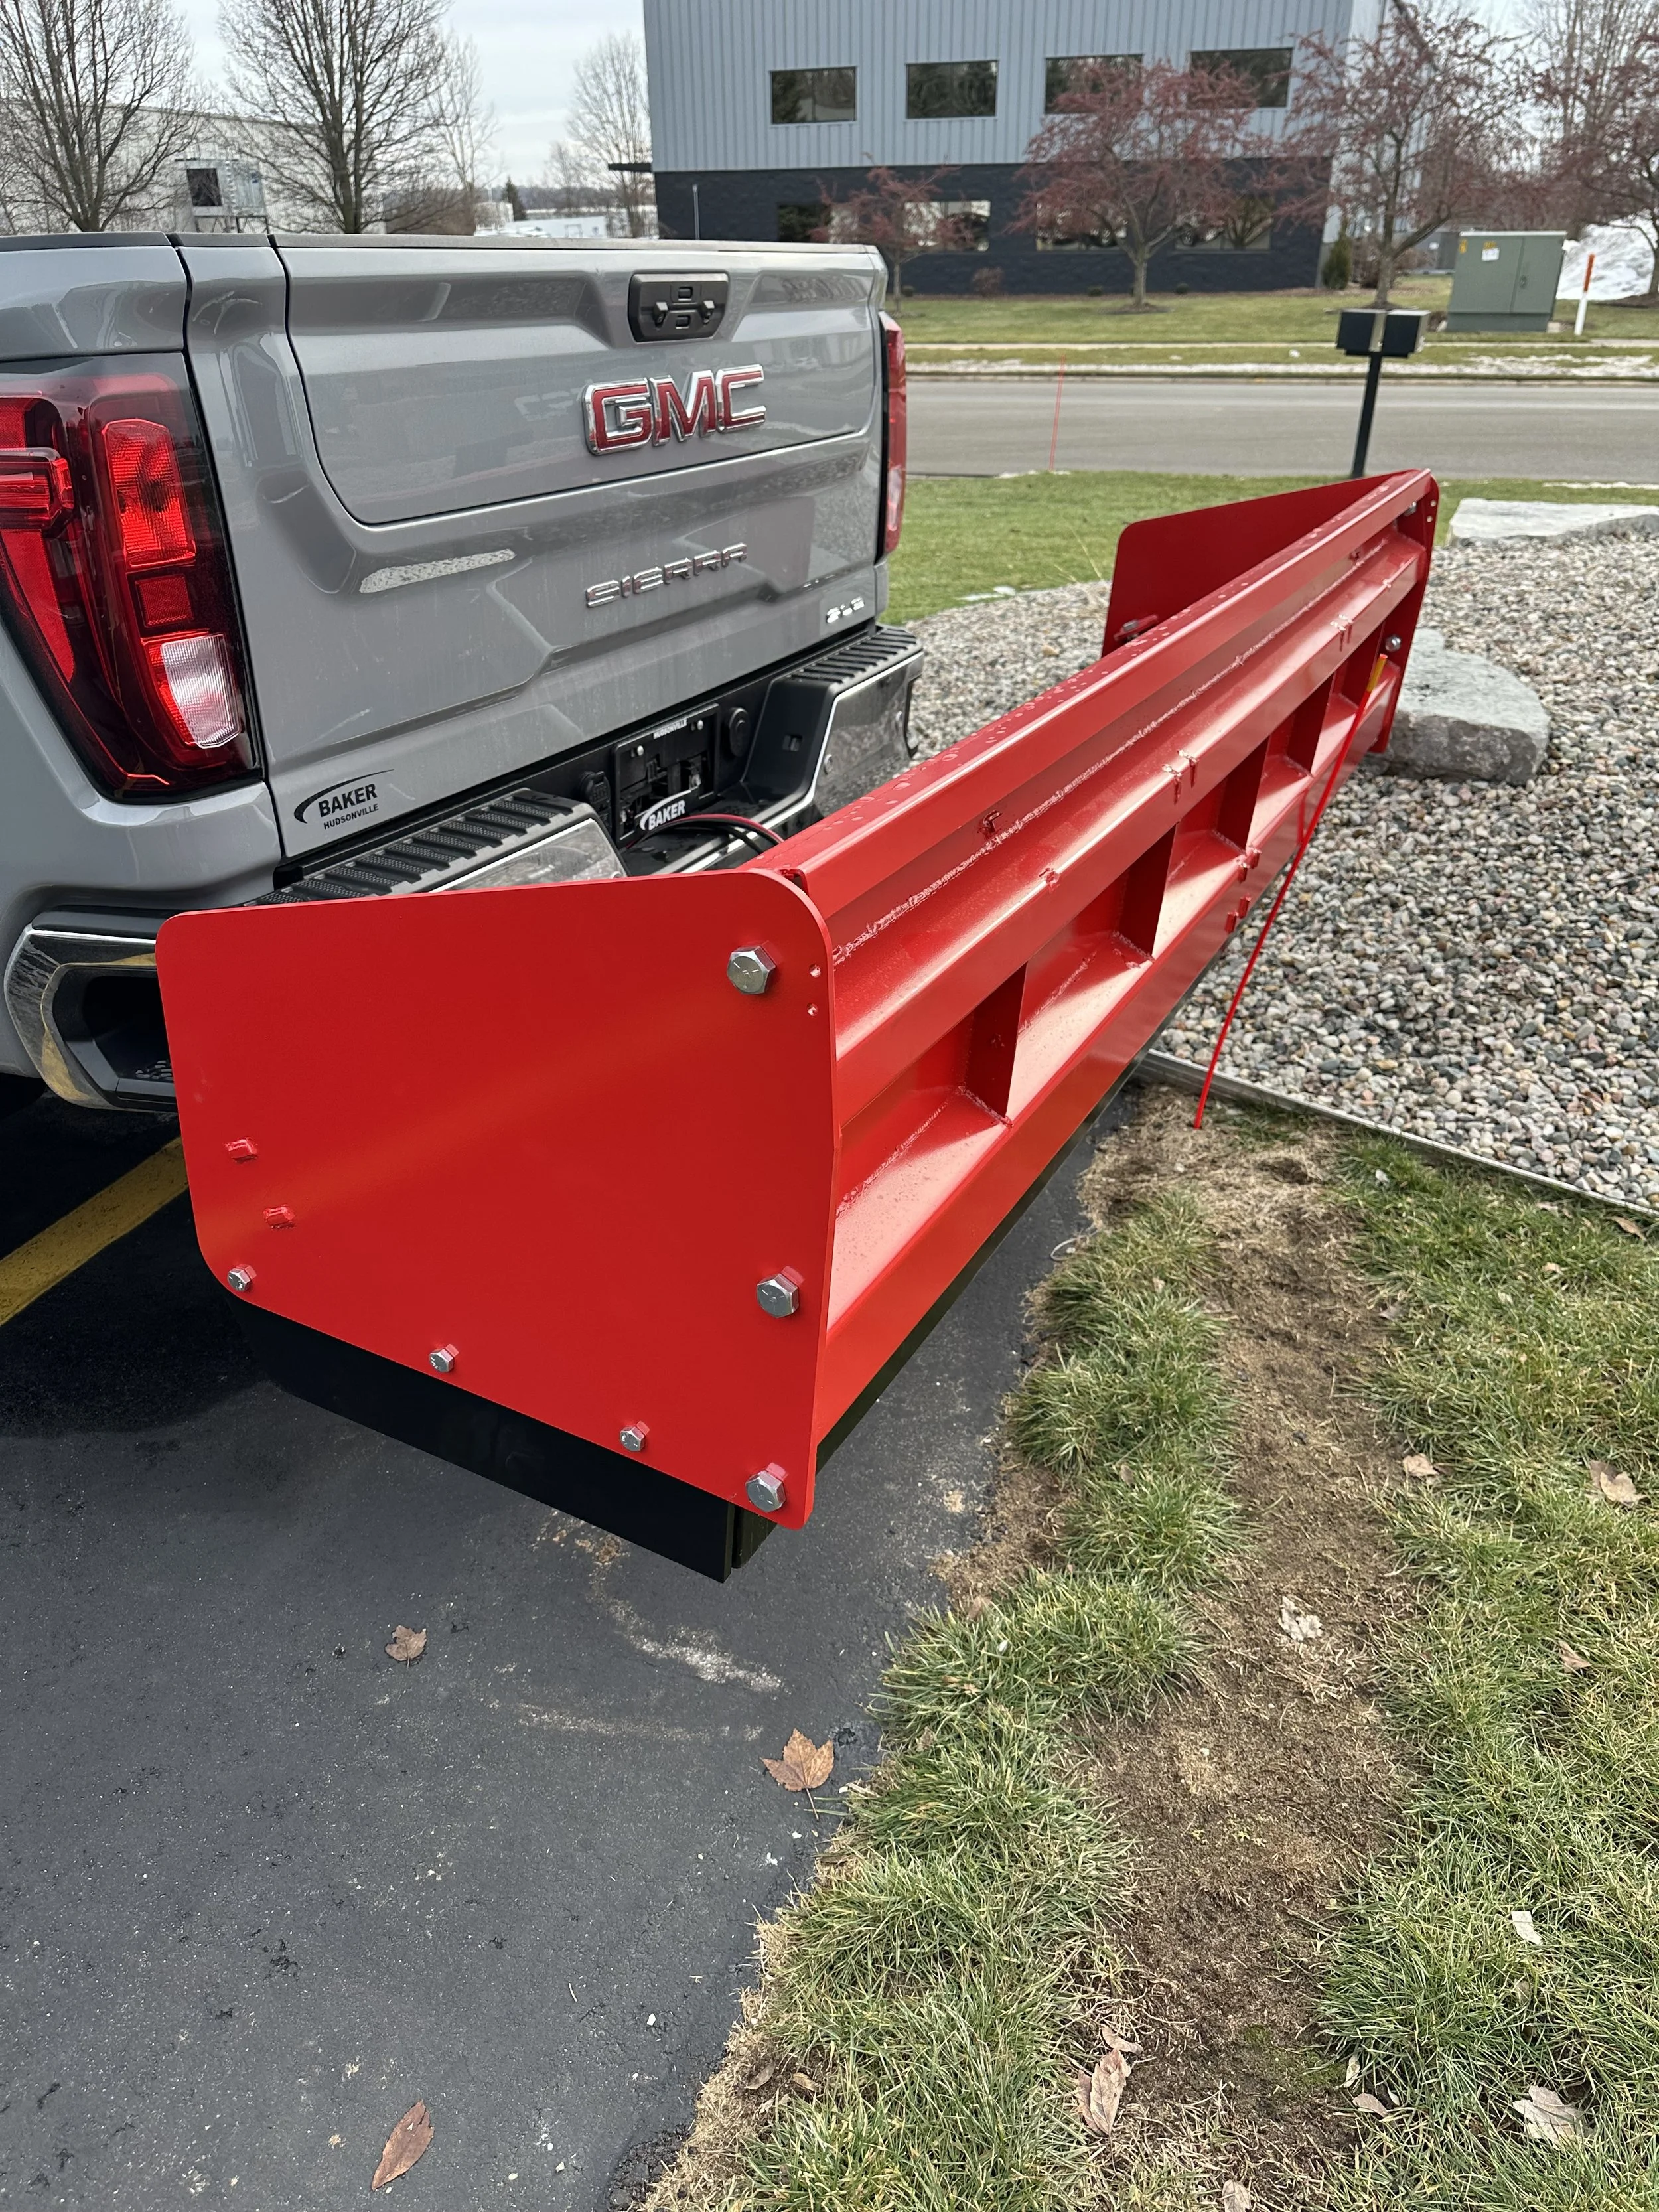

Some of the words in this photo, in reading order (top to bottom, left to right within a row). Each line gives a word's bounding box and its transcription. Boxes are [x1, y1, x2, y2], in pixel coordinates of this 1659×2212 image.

[583, 364, 766, 454] GMC
[586, 542, 747, 607] SIERRA
[319, 784, 378, 817] BAKER
[323, 804, 379, 830] HUDSONVILLE
[648, 800, 685, 830] BAKER
